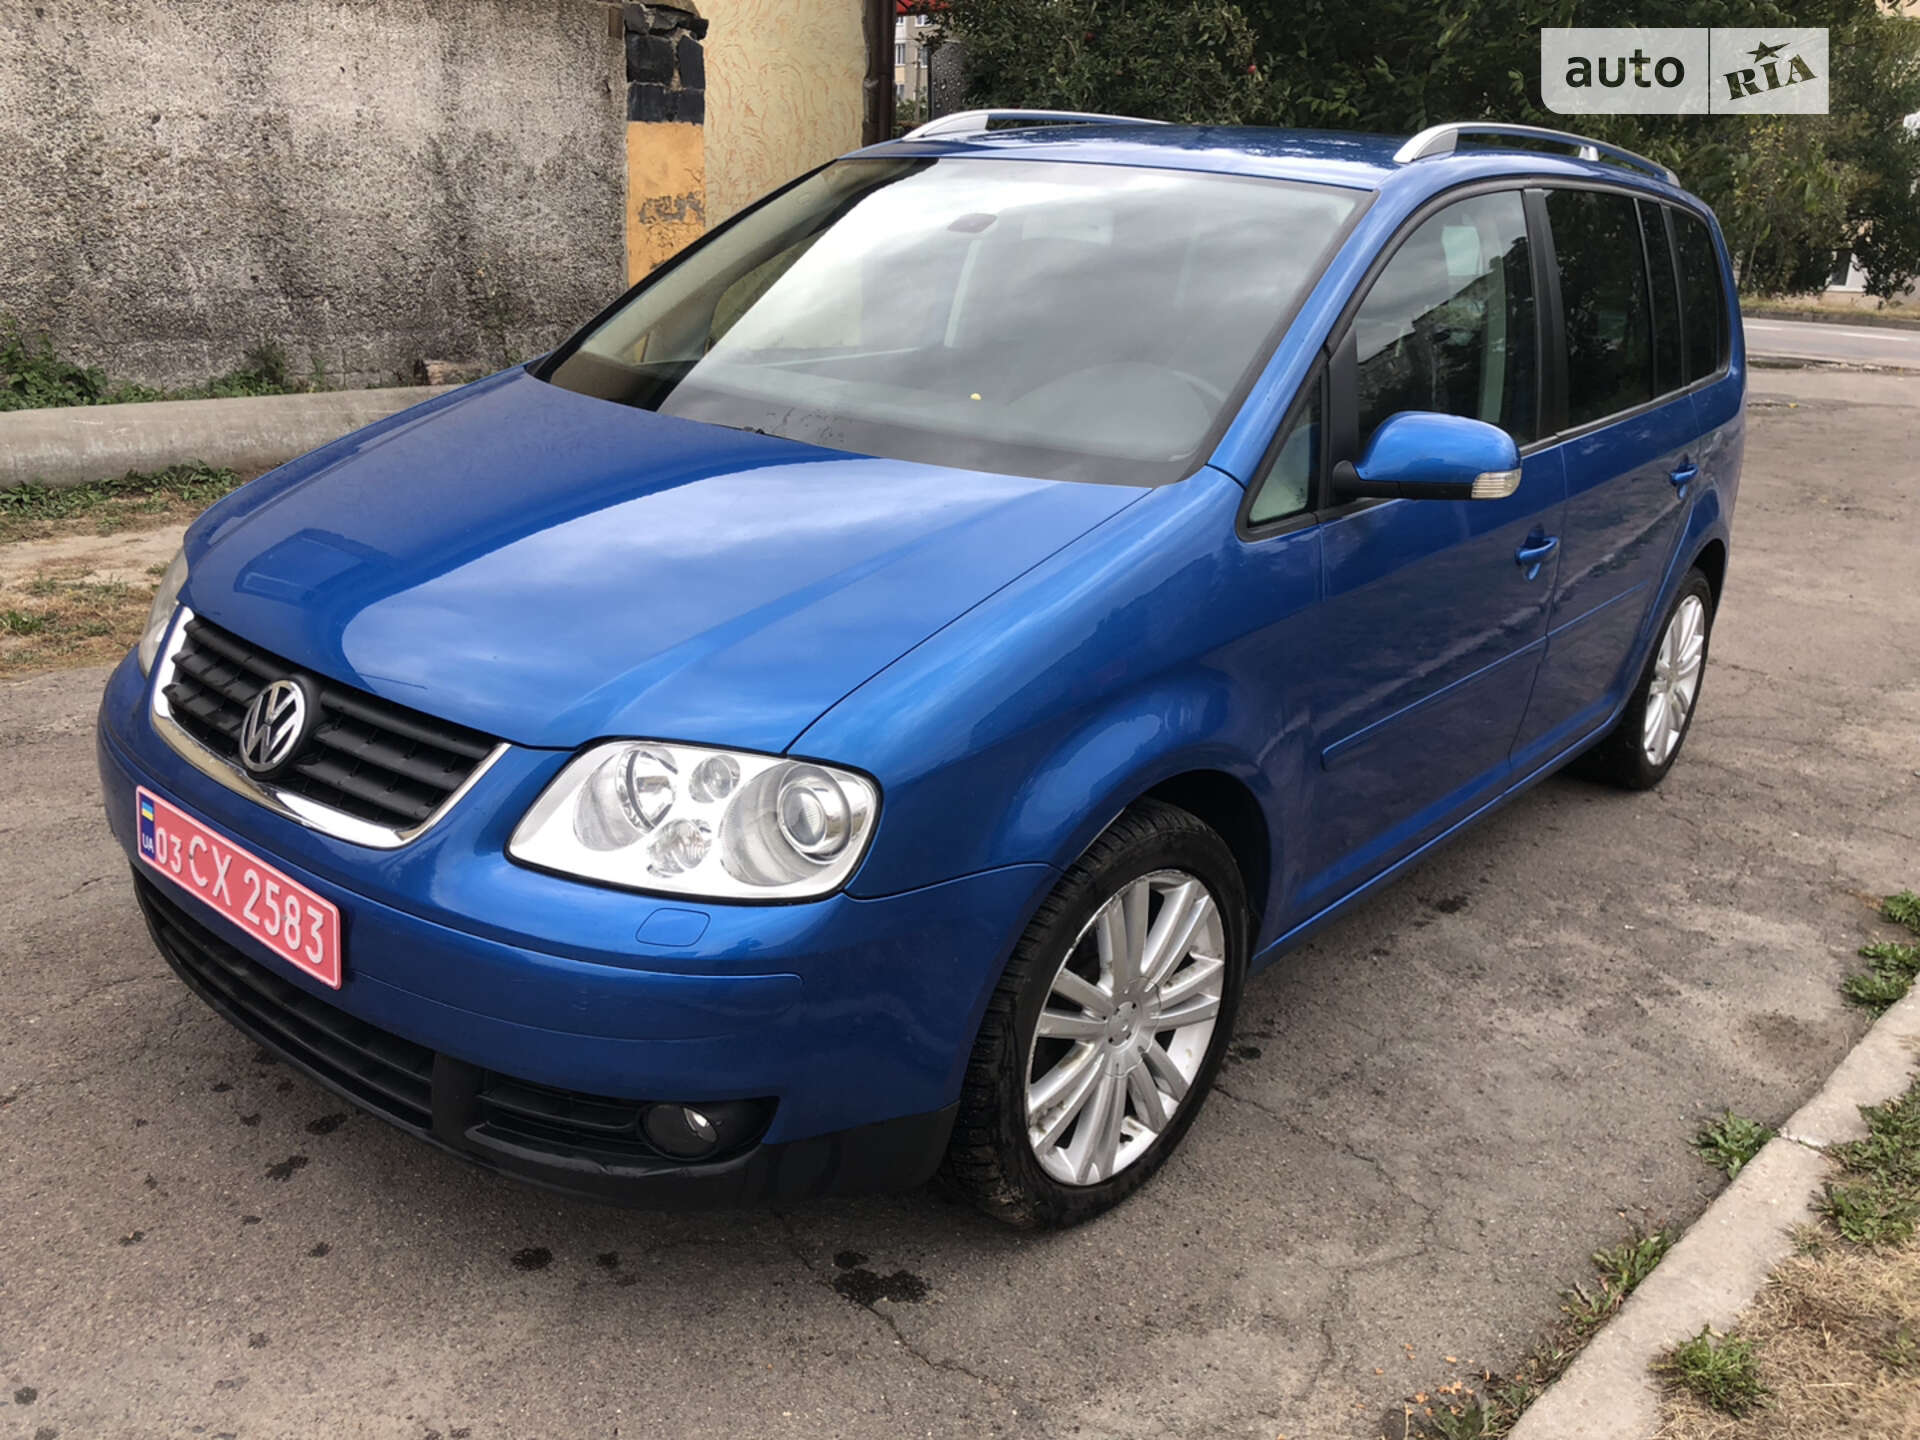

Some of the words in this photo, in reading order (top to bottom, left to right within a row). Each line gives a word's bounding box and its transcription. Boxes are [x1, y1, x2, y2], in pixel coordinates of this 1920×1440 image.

[143, 833, 155, 854] UA
[155, 827, 182, 874] 03
[189, 835, 233, 906] CX
[242, 868, 325, 964] 2583
